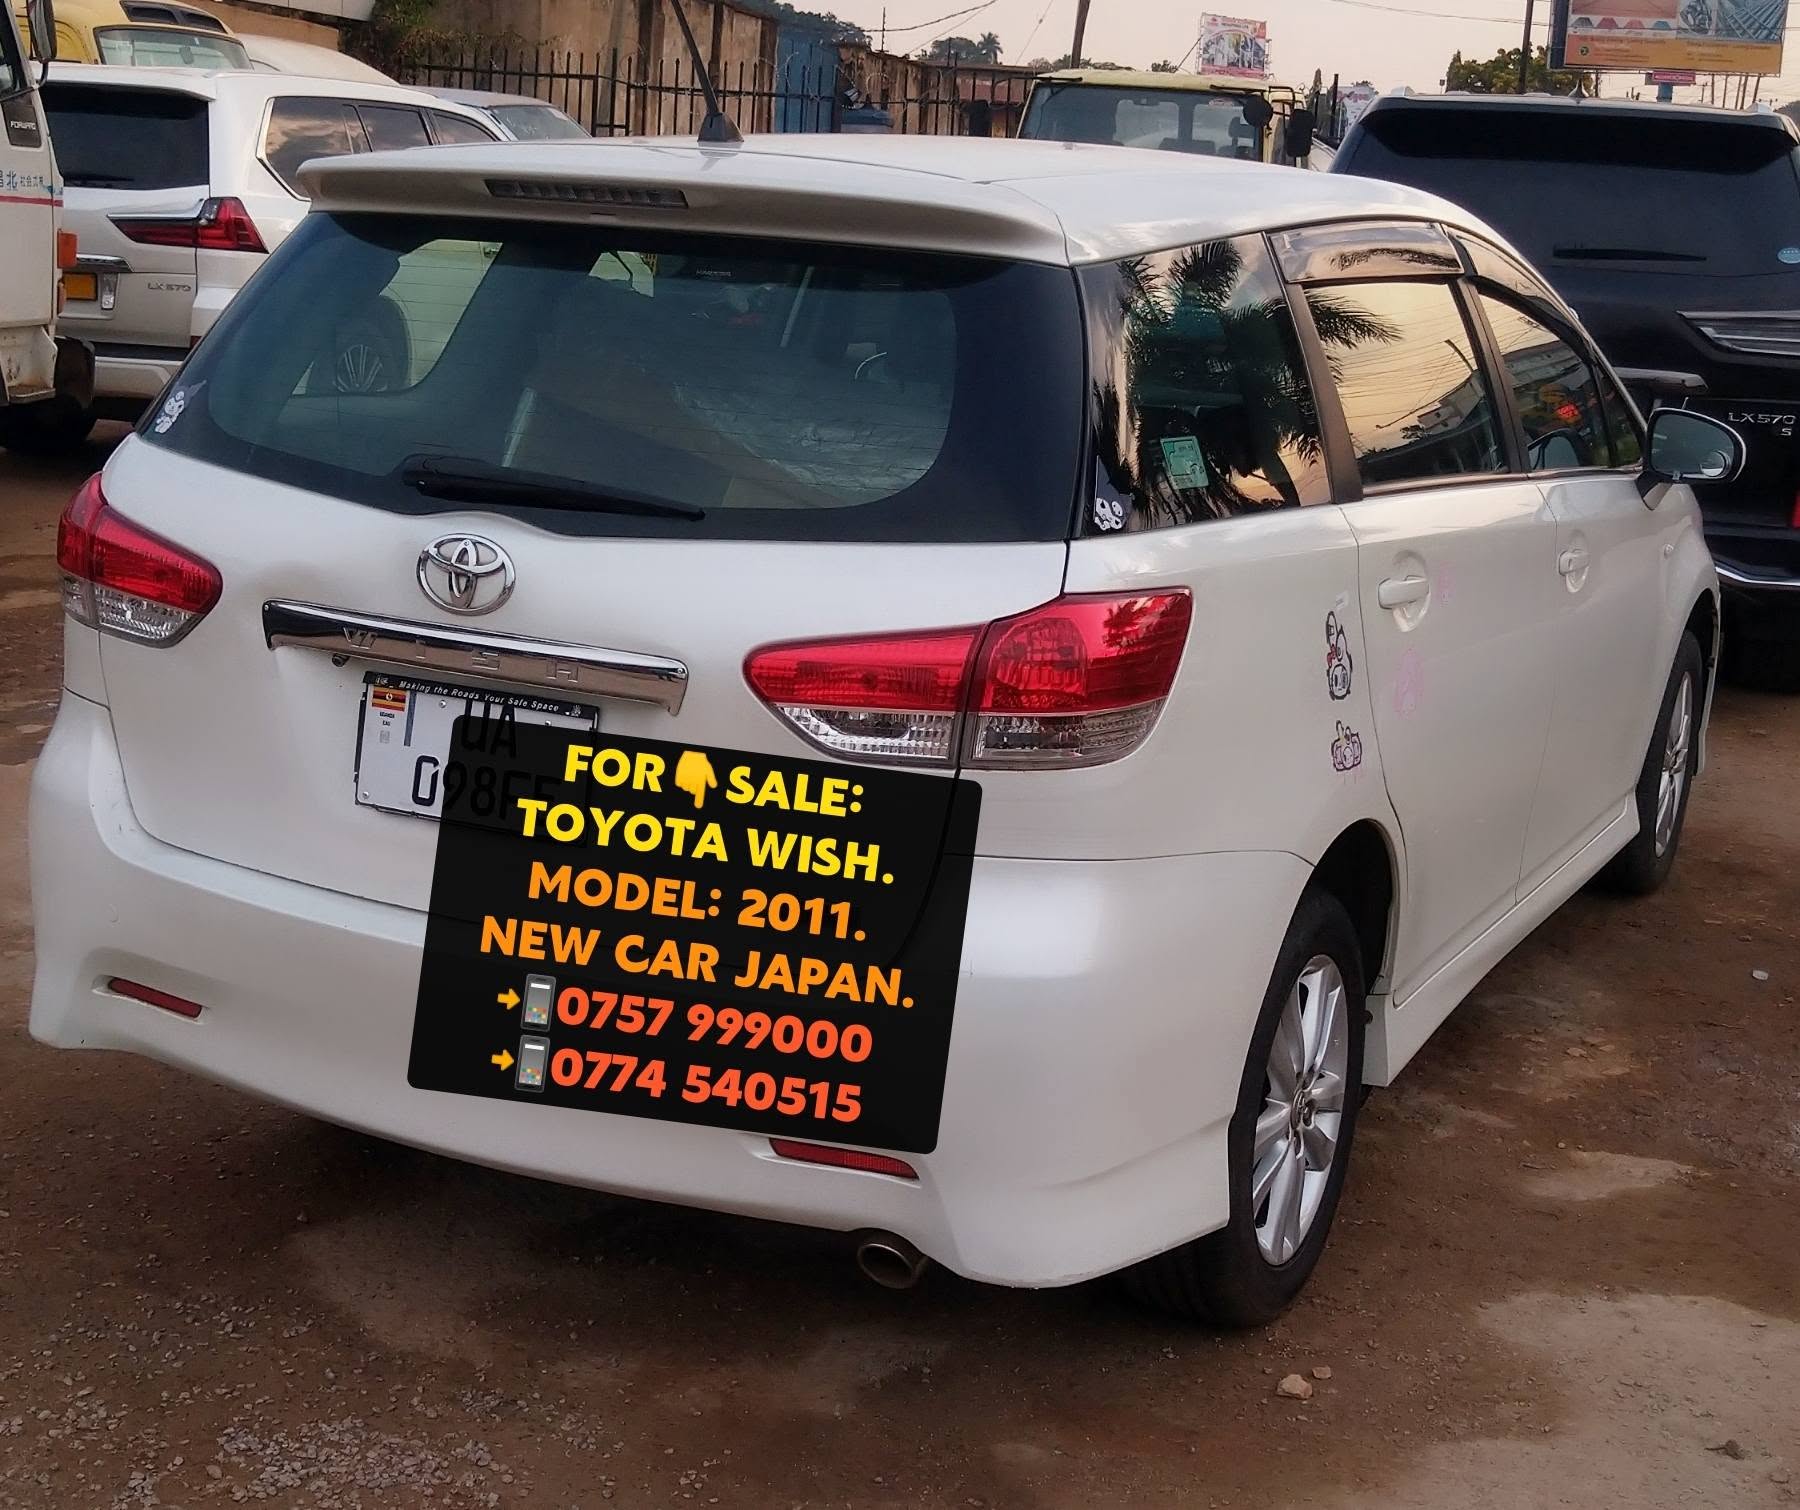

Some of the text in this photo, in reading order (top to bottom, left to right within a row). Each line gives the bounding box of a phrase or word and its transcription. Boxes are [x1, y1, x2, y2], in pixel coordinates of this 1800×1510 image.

[1728, 411, 1797, 425] LX570
[1781, 427, 1793, 437] S
[343, 626, 580, 684] WISH
[398, 680, 559, 712] Making the Roads Your Safe Space
